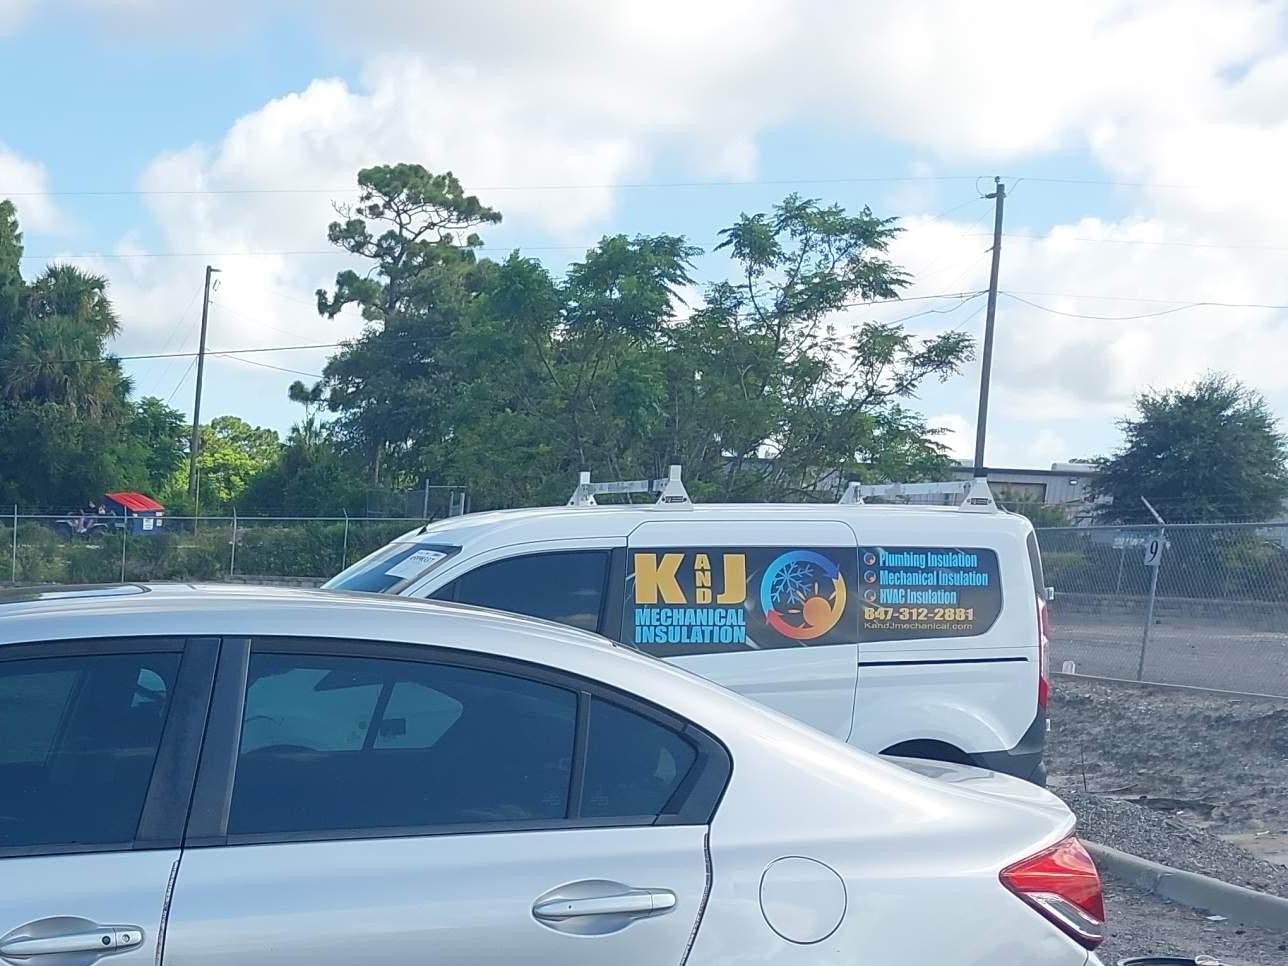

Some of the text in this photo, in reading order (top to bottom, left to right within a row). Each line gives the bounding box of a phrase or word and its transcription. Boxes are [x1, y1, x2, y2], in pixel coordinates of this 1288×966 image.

[1147, 540, 1159, 562] 9
[879, 552, 977, 568] Plumbing Insulation
[634, 553, 747, 604] K AND J
[879, 570, 988, 586] Mechanical Insulation
[879, 588, 957, 604] HVAC Insulation
[634, 608, 746, 626] MECHANICAL
[864, 607, 974, 621] 847-312-2881
[634, 626, 746, 643] INSULATION
